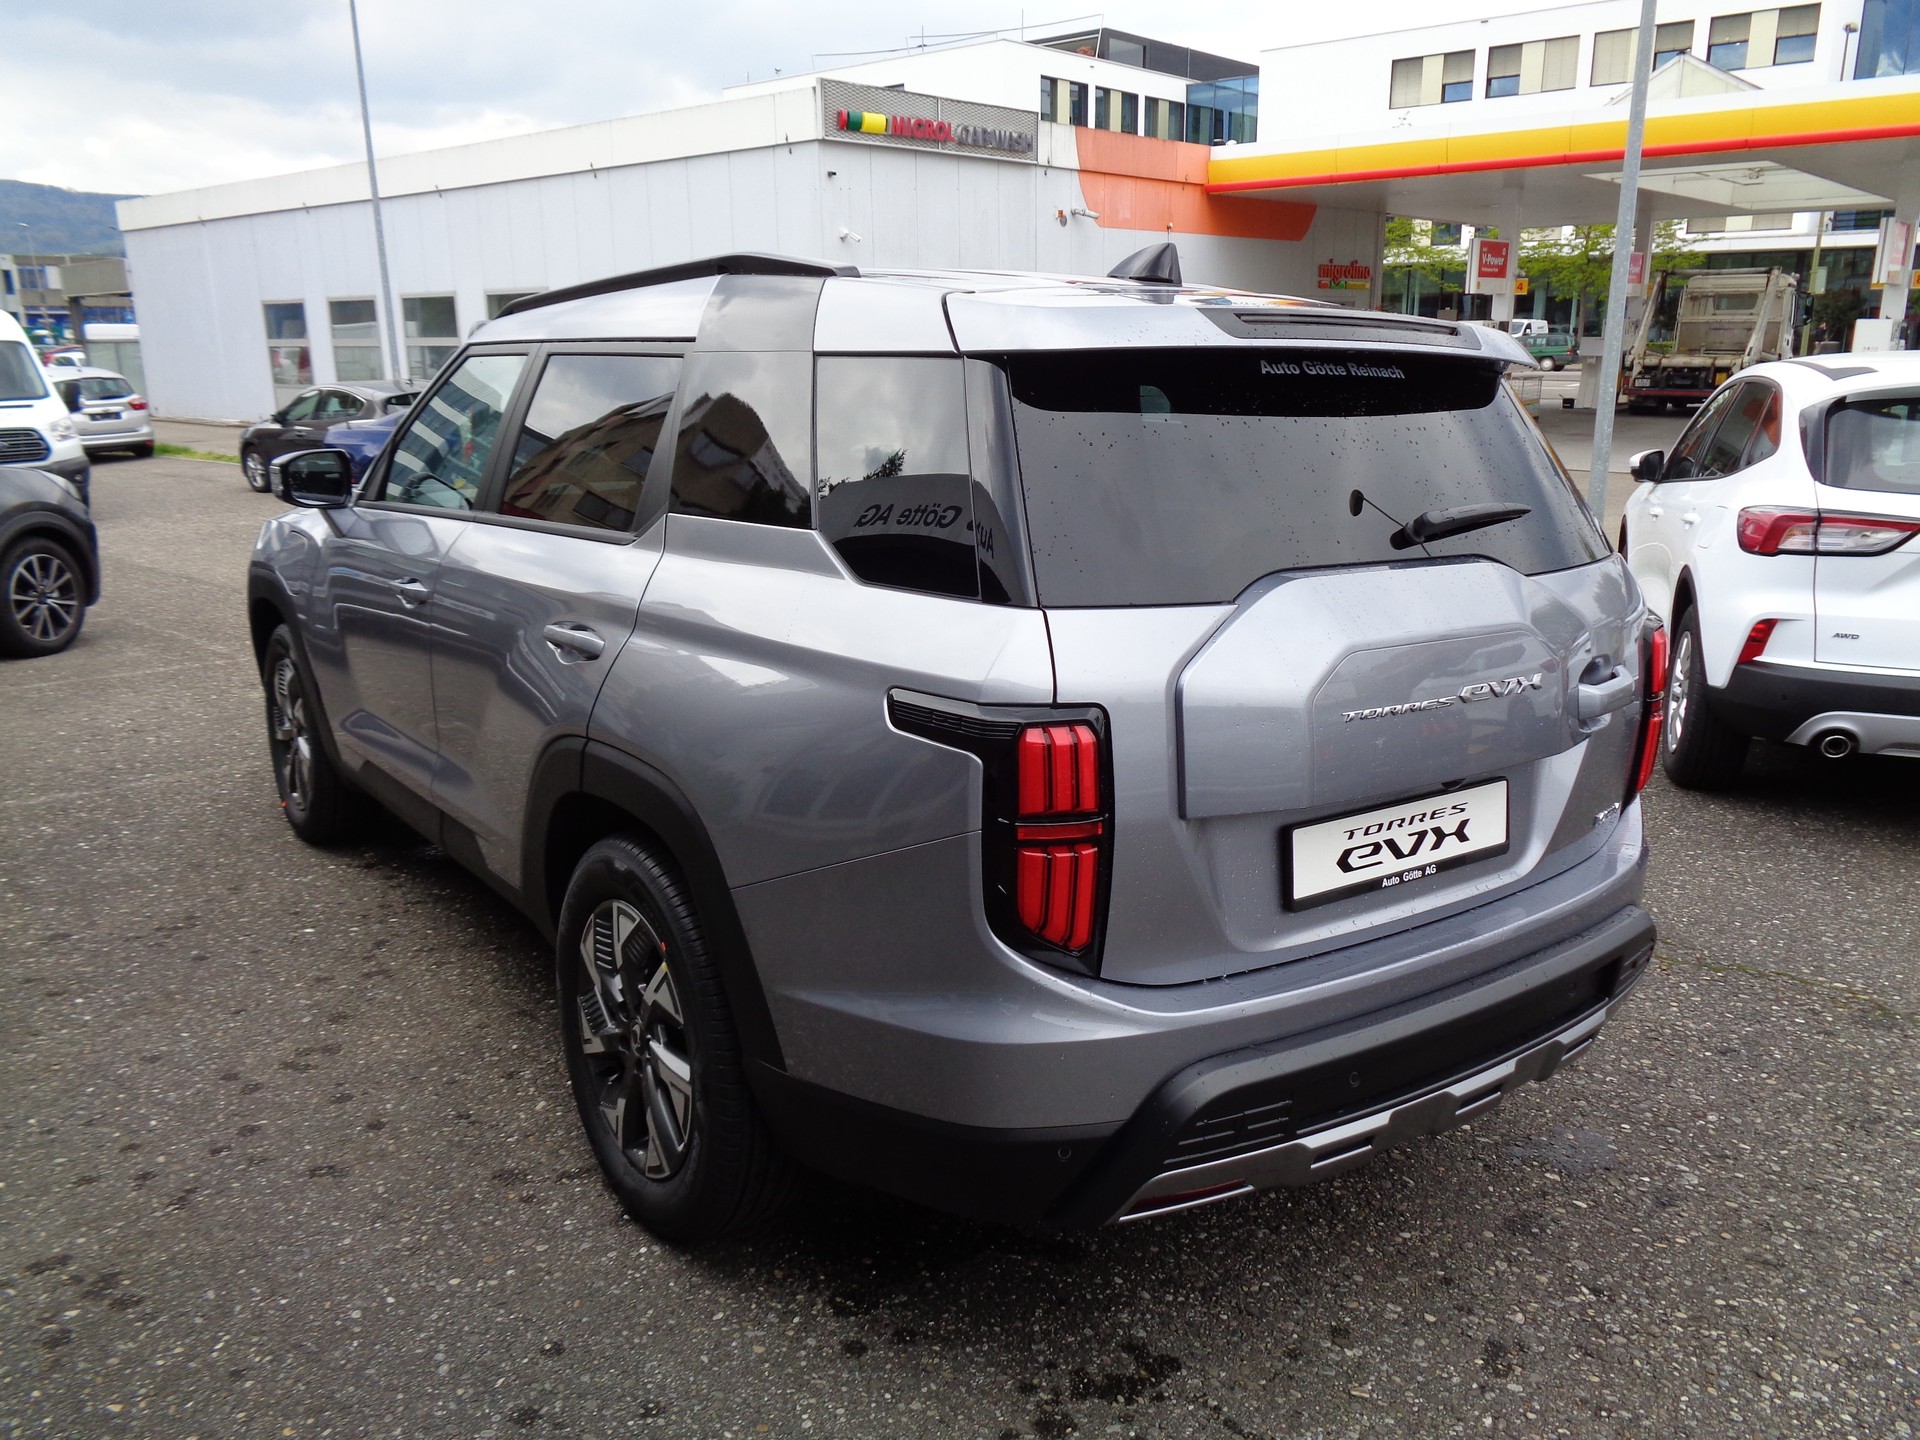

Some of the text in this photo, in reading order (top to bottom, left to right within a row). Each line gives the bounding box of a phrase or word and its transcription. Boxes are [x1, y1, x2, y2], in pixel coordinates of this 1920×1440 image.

[891, 115, 956, 142] MIGROL
[1482, 253, 1504, 266] V-Power
[1318, 258, 1371, 286] migrolino
[1516, 282, 1524, 291] 4
[1260, 360, 1405, 379] Auto Götte Reinach
[1832, 632, 1860, 640] AWD
[1341, 696, 1457, 723] TORRES
[1343, 802, 1468, 840] TORRES
[1382, 864, 1437, 888] Auto Götte AG
